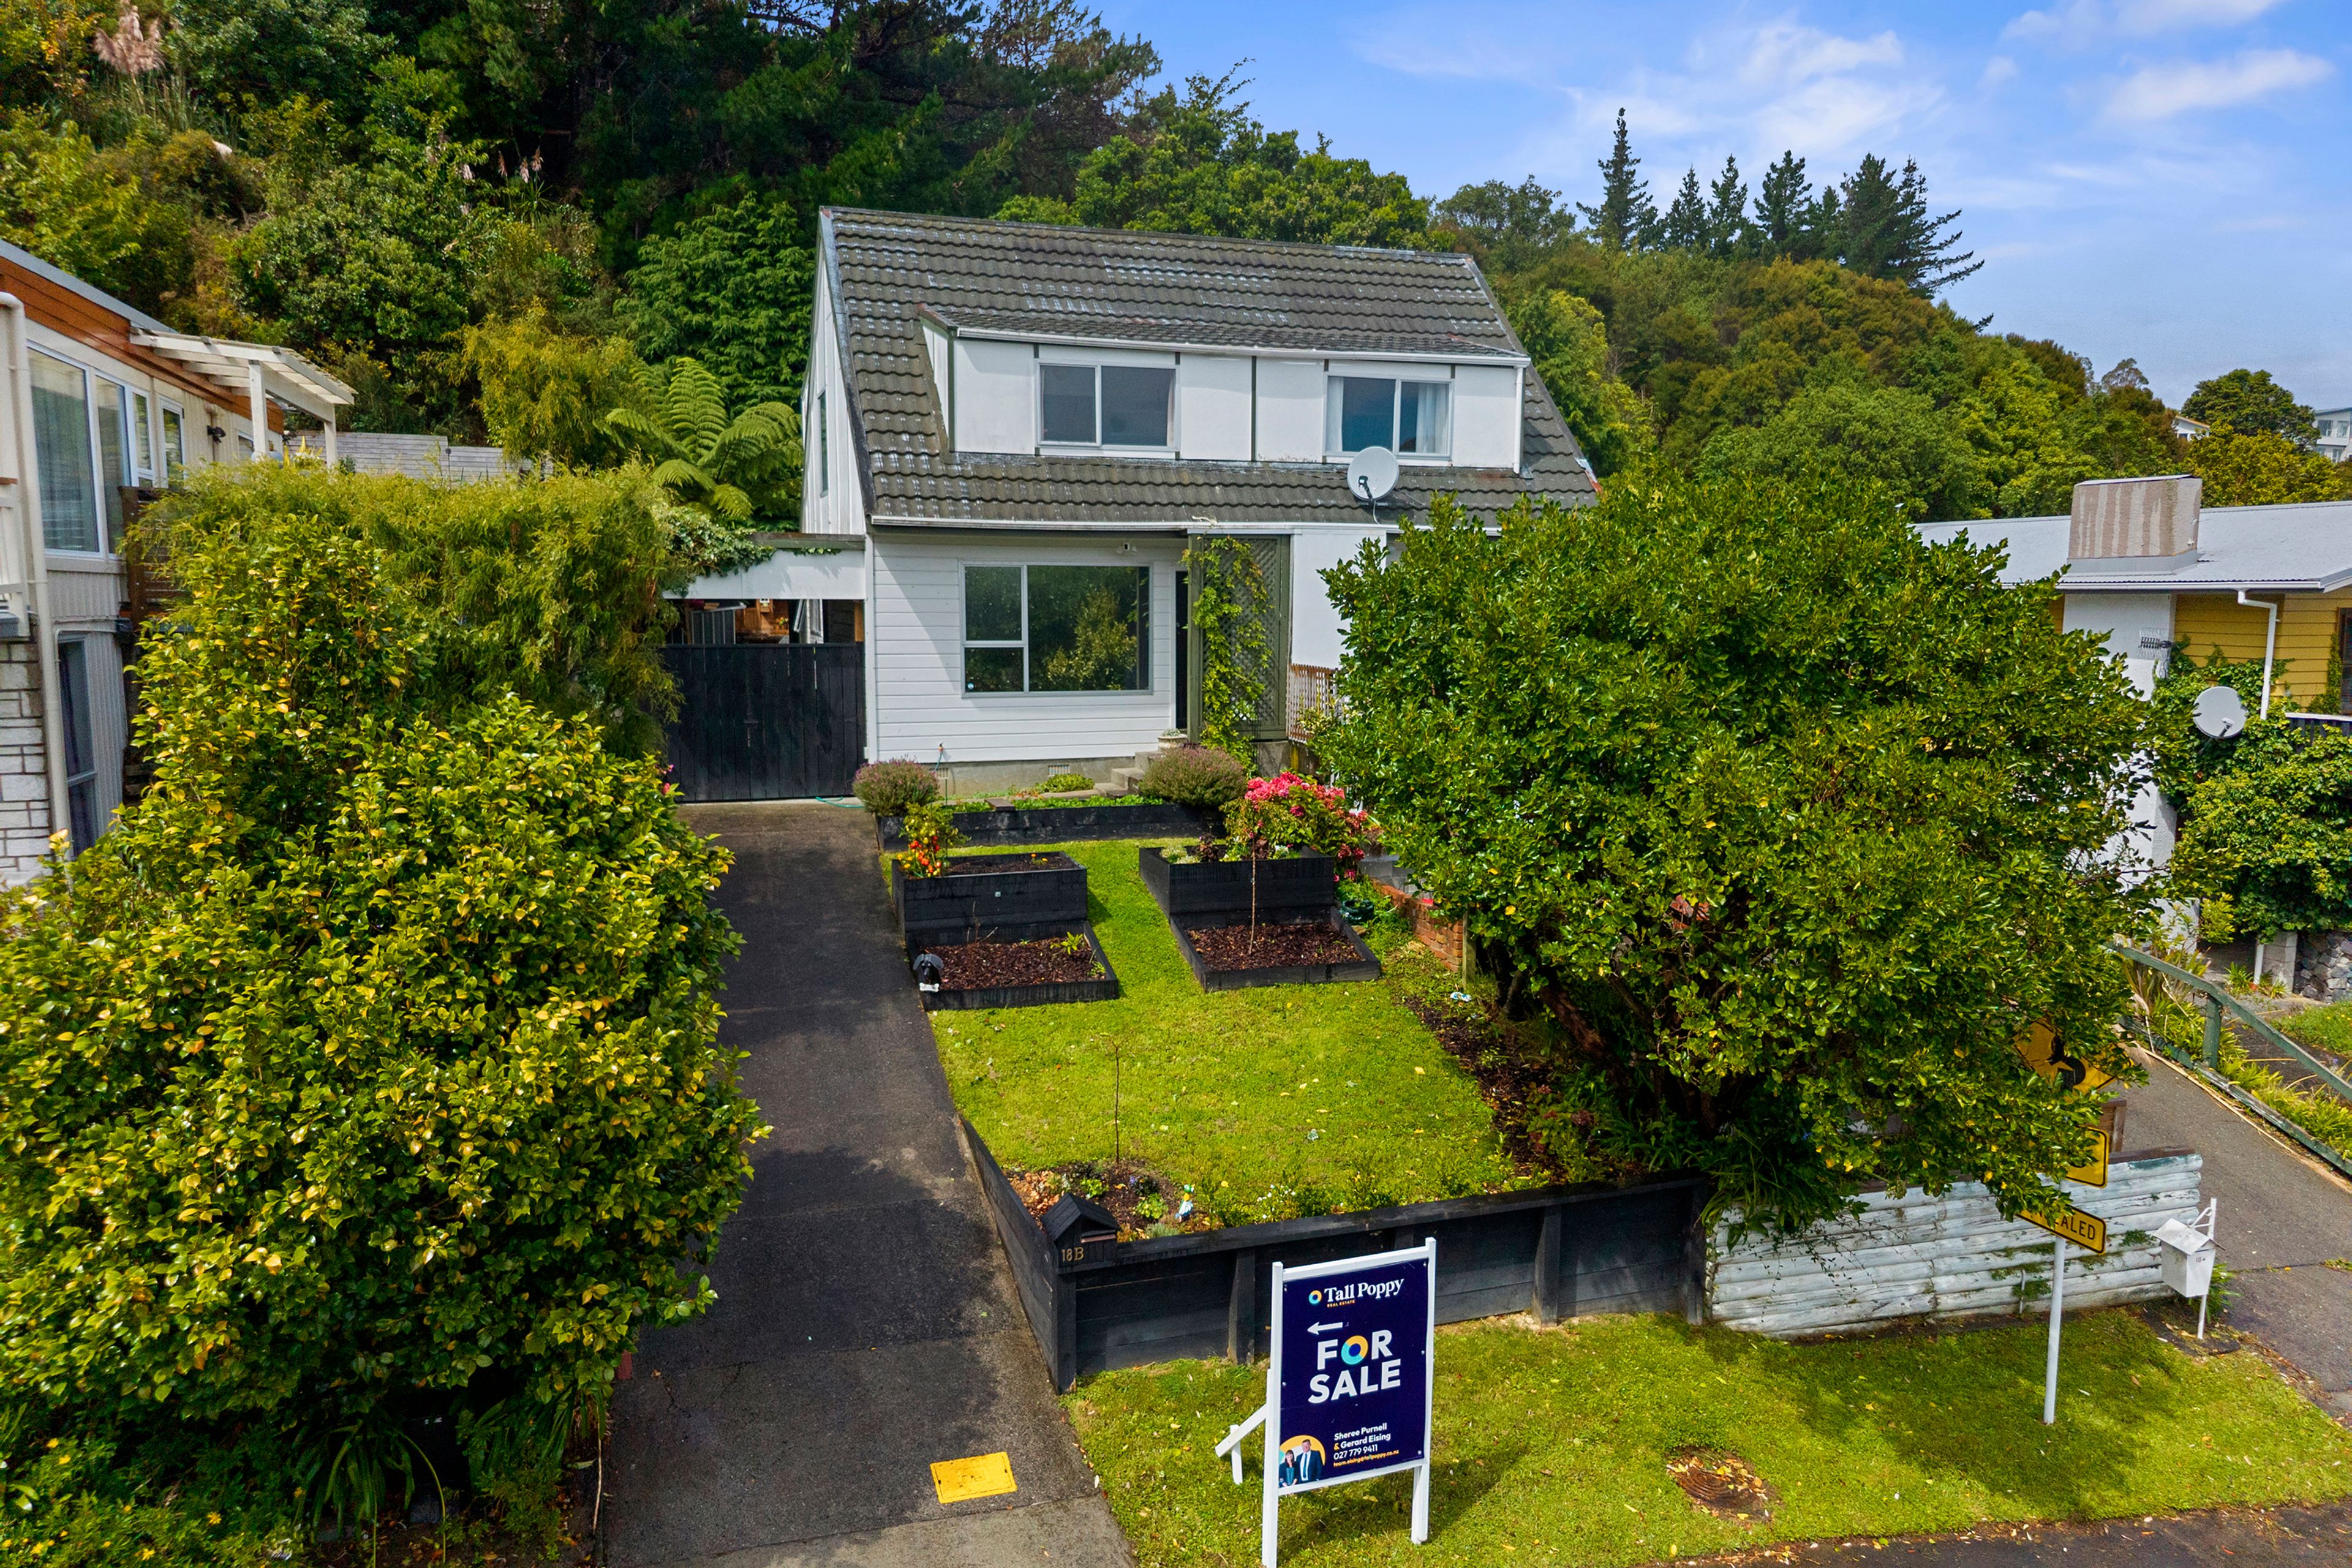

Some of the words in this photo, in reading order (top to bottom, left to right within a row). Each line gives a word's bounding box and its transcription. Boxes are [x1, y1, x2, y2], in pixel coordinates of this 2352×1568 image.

[1324, 1284, 1355, 1302] Tall
[1357, 1278, 1404, 1299] Poppy
[1317, 1329, 1393, 1370] FOR
[1308, 1359, 1401, 1404] SALE
[1334, 1432, 1360, 1441] Sheree
[1361, 1422, 1387, 1434] Purnell
[1340, 1436, 1368, 1449] Gerard
[1368, 1433, 1391, 1443] Eising
[1333, 1450, 1348, 1460] 027
[1349, 1447, 1362, 1457] 779
[1363, 1444, 1378, 1454] 9411
